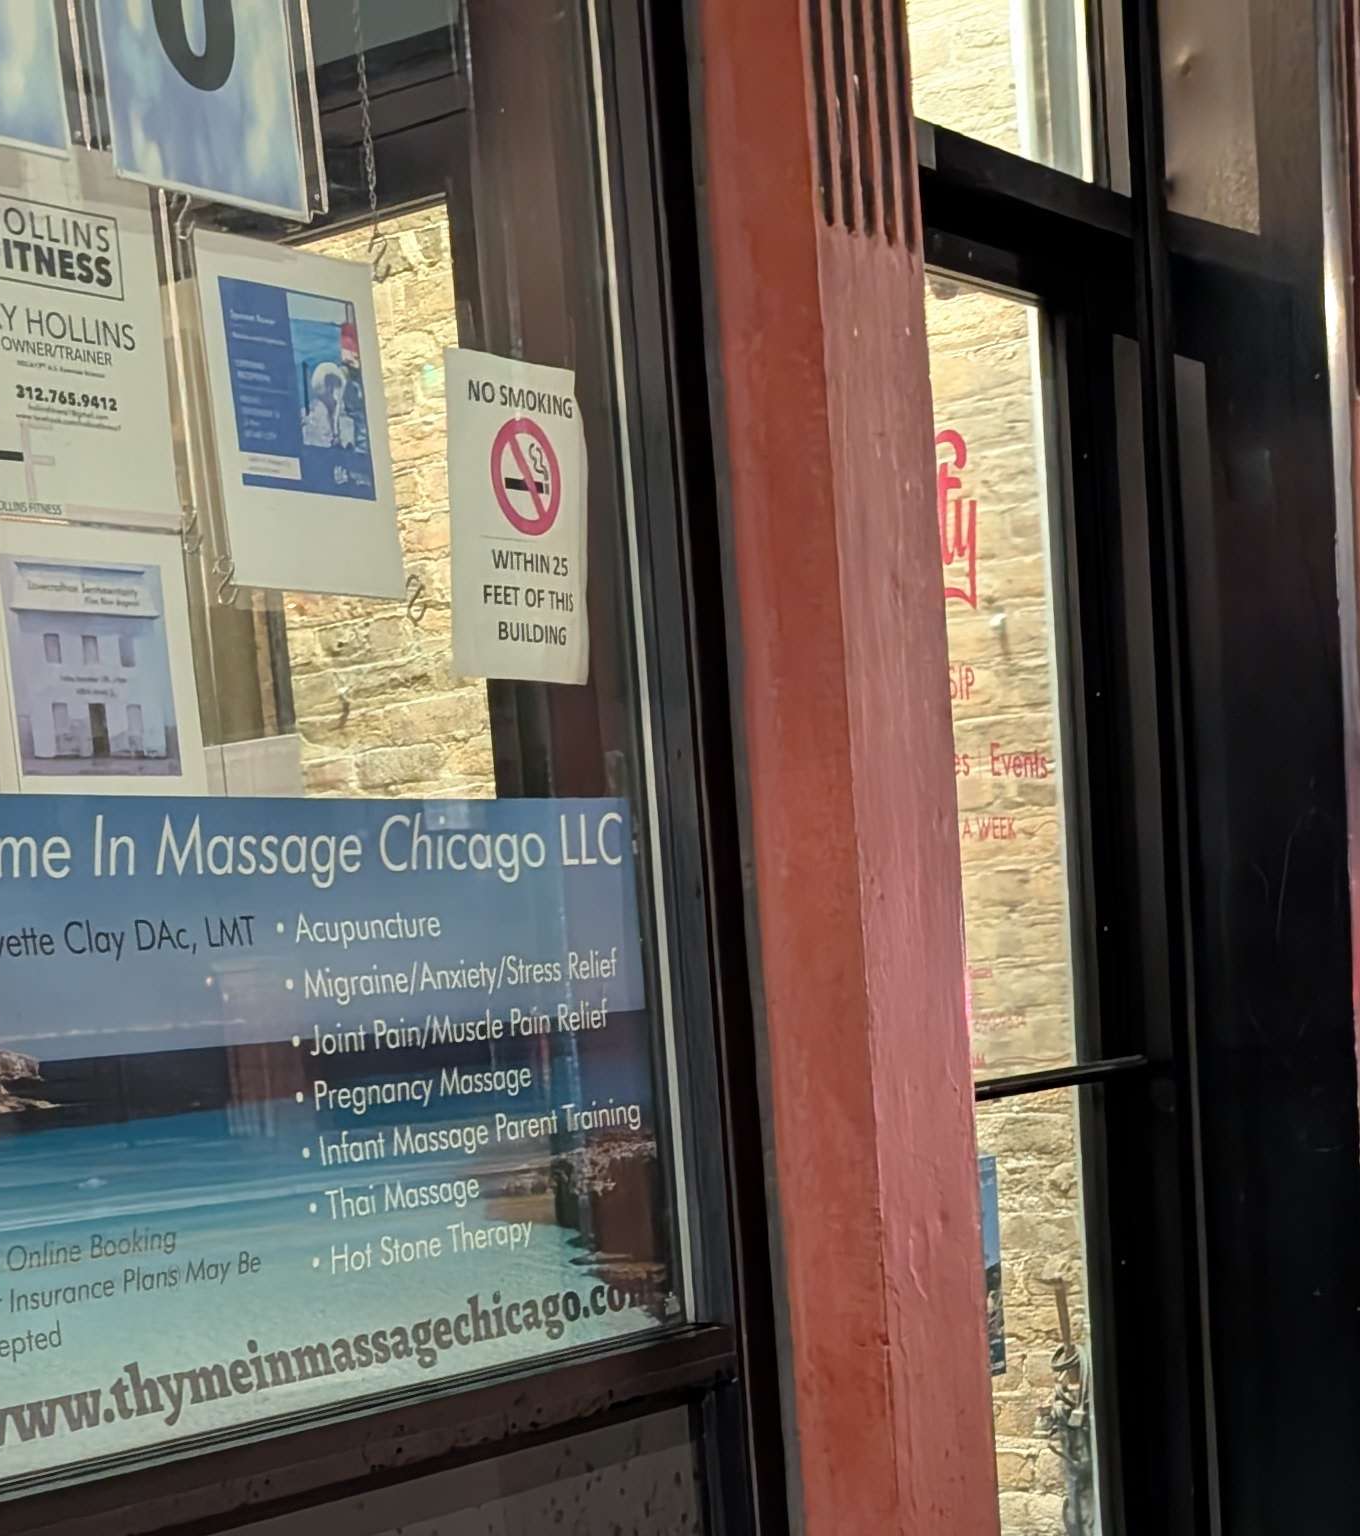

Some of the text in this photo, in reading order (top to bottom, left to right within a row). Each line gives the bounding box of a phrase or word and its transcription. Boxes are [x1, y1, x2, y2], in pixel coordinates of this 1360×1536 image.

[1, 335, 113, 367] OWNER/TRAINER
[26, 307, 136, 351] HOLLINS
[15, 384, 118, 412] 312.765.9412
[468, 379, 573, 419] NO SMOKING
[491, 548, 569, 577] WITHIN 25
[483, 584, 574, 613] FEET OF THIS
[498, 621, 567, 647] BUILDING
[990, 742, 1049, 779] Events
[976, 815, 1017, 841] WEEK
[94, 814, 136, 877] In
[156, 812, 363, 889] Massage
[380, 812, 546, 883] Chicago
[560, 812, 624, 866] LLC
[64, 920, 125, 962] Clay
[135, 918, 197, 955] DAc,
[205, 915, 255, 949] LMT
[296, 911, 441, 949] Acupuncture
[304, 947, 618, 1006] Migraine/Anxiety/Stress Relief
[310, 998, 608, 1057] Joint Pain/Muscle Pain Relief
[313, 1066, 532, 1116] Pregnancy Massage
[319, 1098, 641, 1166] Infant Massage Parent Training
[325, 1176, 480, 1220] Thai Massage
[6, 1241, 82, 1272] Online
[90, 1227, 177, 1260] Booking
[331, 1220, 533, 1275] Hot Stone Therapy
[9, 1279, 115, 1313] Insurance
[123, 1266, 179, 1294] Plans
[186, 1258, 231, 1285] May
[237, 1251, 262, 1275] Be
